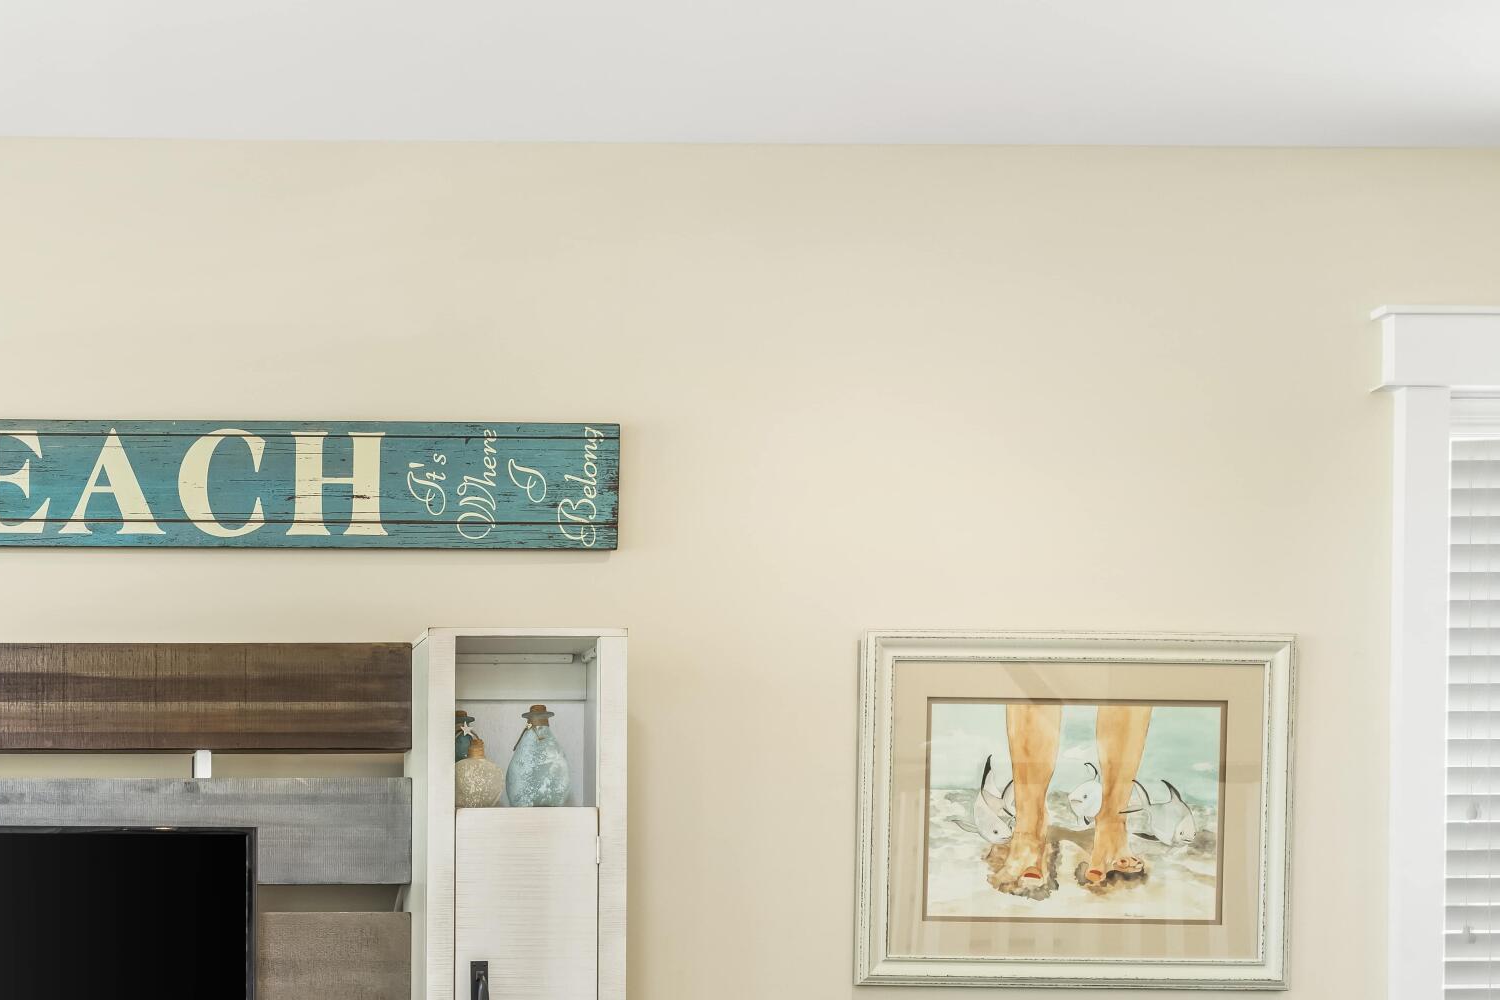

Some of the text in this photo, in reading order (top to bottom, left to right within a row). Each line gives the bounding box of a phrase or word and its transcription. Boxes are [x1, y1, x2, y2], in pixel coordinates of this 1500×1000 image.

[407, 452, 447, 515] It's
[456, 429, 498, 540] Where
[508, 458, 547, 503] I
[557, 426, 605, 547] Belong
